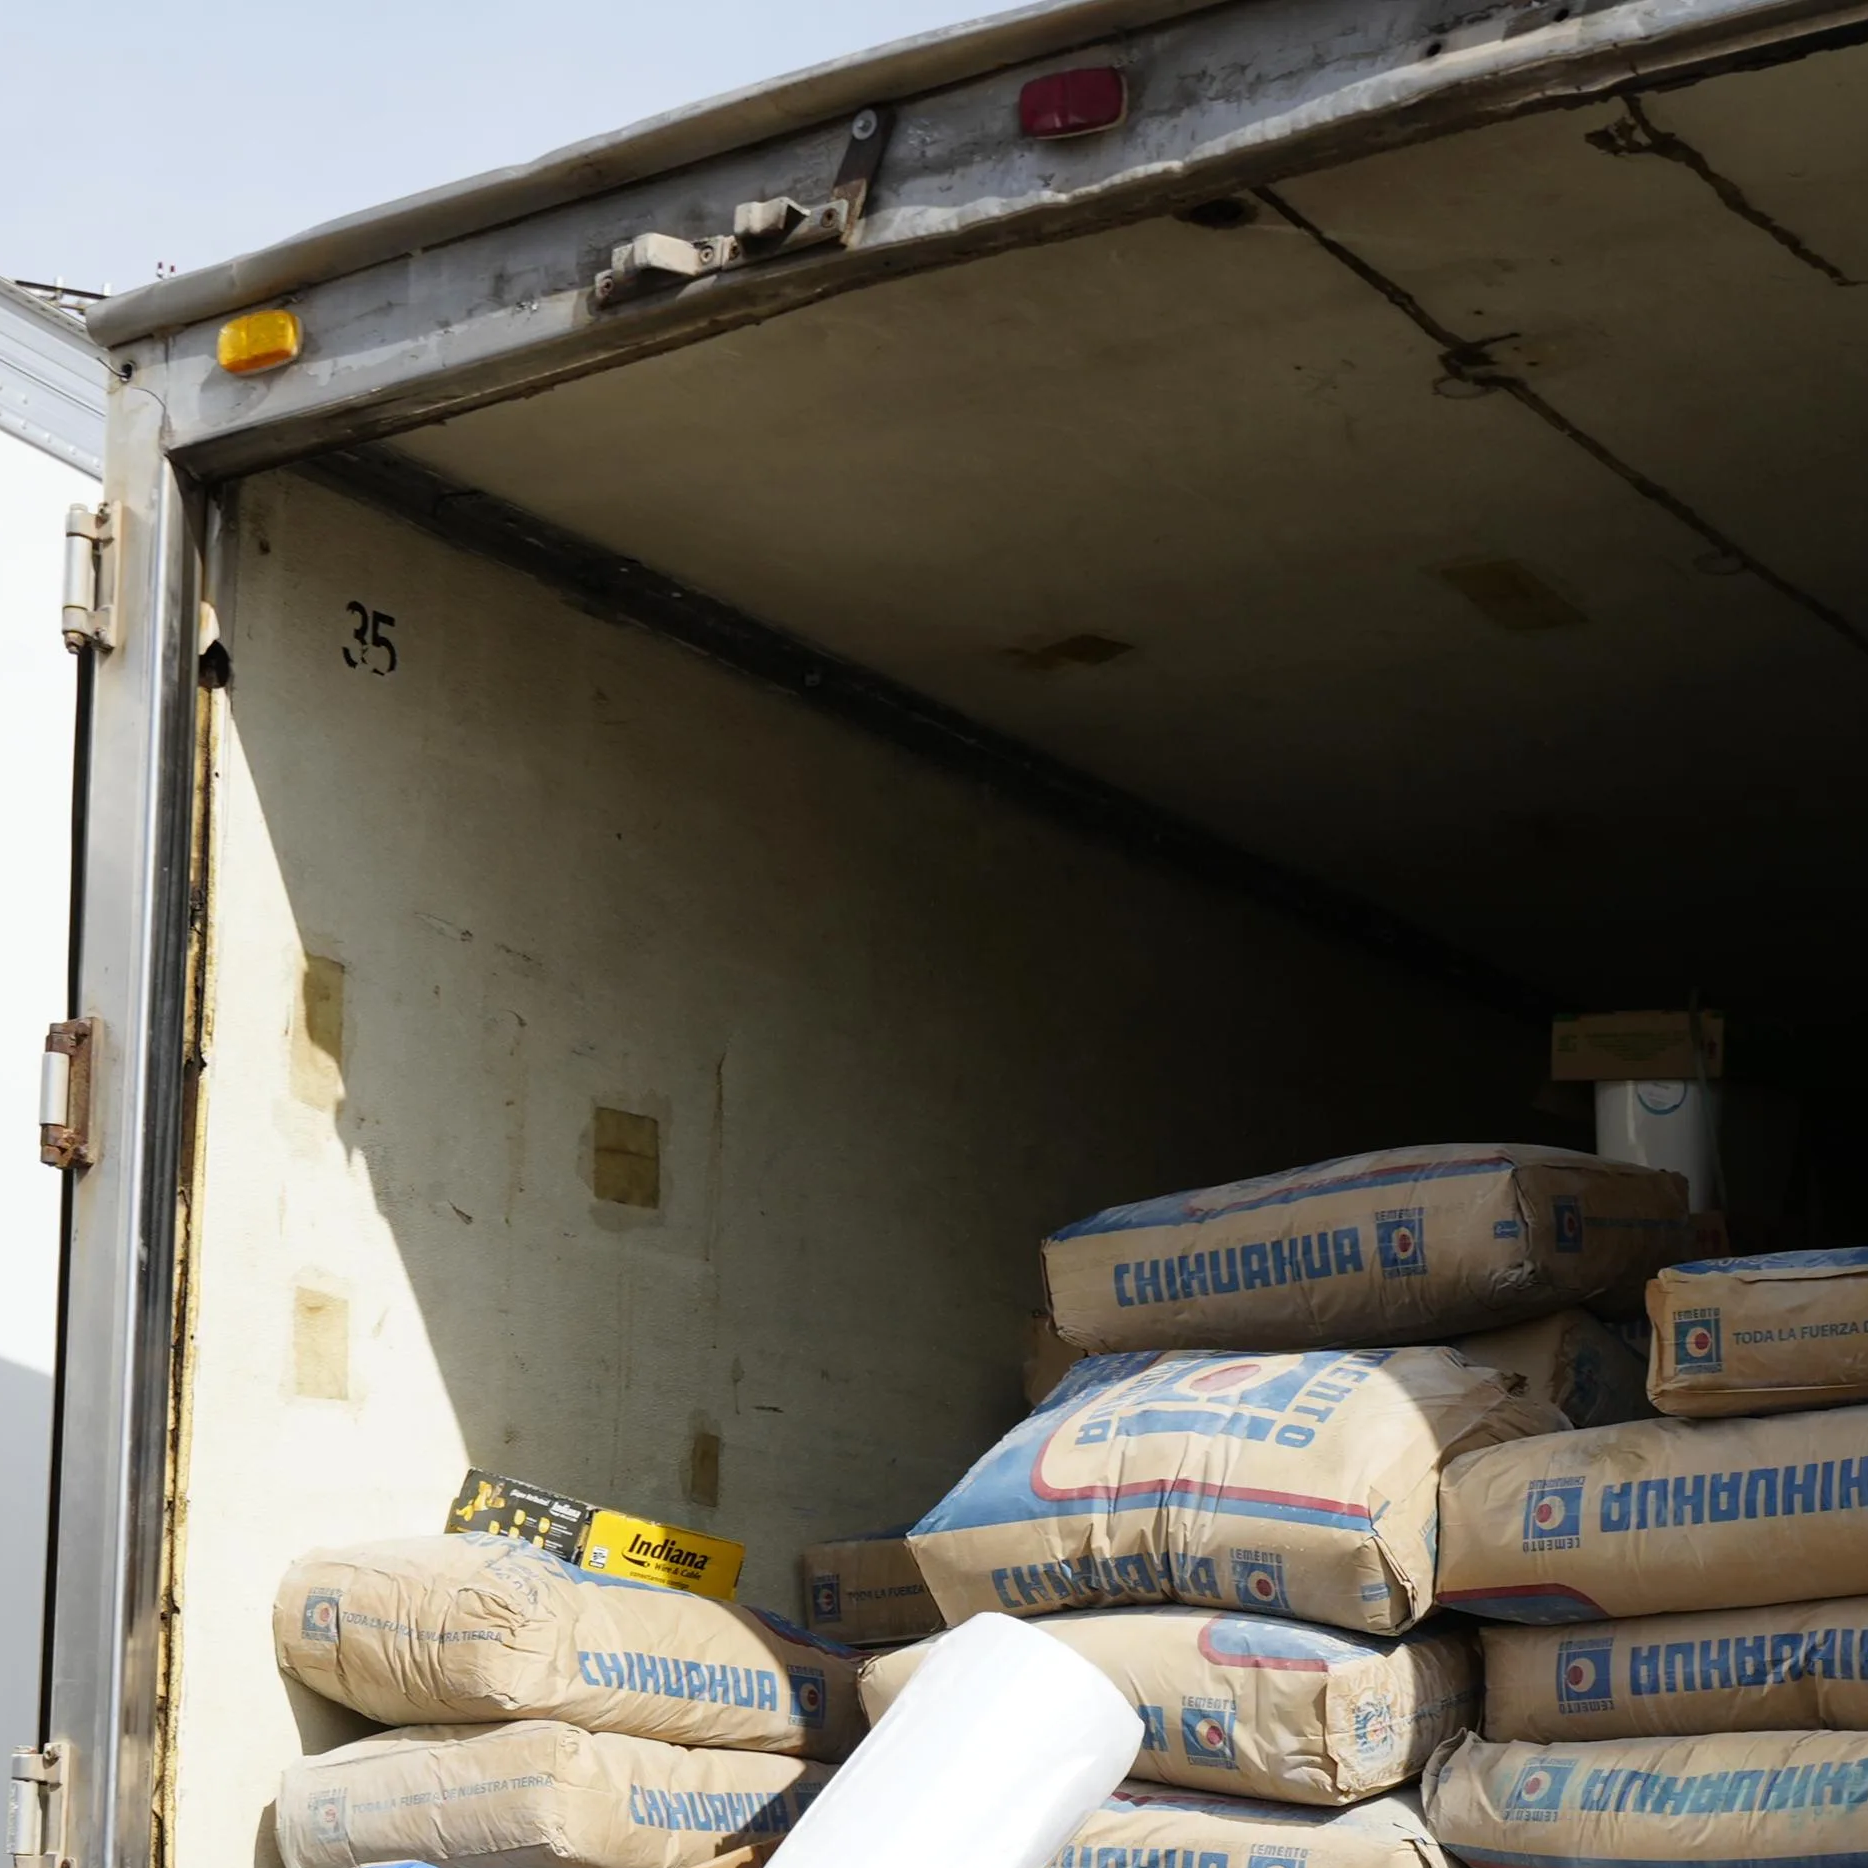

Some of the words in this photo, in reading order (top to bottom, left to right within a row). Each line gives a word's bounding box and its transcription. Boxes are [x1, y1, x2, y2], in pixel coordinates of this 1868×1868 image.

[342, 601, 397, 676] 35
[1114, 1227, 1364, 1307] CHIHUAHUA
[1733, 1331, 1774, 1345] TODA
[1778, 1328, 1796, 1342] LA
[1801, 1321, 1859, 1339] FUERZA
[628, 1534, 708, 1570] Indiana
[1231, 1548, 1283, 1564] CEMENTO
[992, 1553, 1222, 1610] CHIHUAHUA
[462, 1629, 503, 1643] TIERRA
[578, 1651, 777, 1712] CHIHUAHUA
[458, 1779, 508, 1797] NUESTRA
[511, 1775, 553, 1788] TIERRA
[630, 1783, 790, 1832] CHIHUAHUA
[1251, 1844, 1308, 1858] CEMENTO
